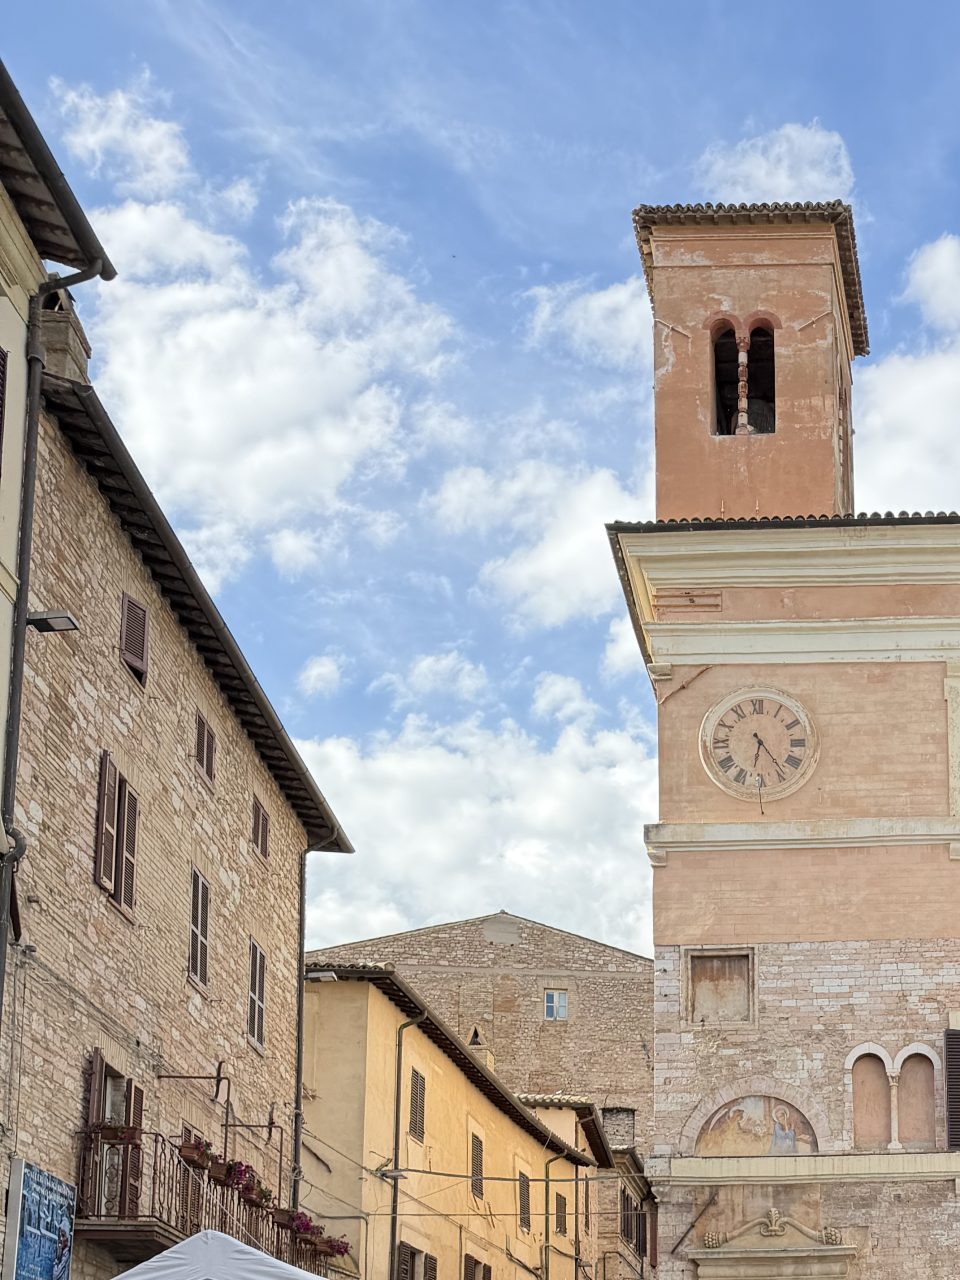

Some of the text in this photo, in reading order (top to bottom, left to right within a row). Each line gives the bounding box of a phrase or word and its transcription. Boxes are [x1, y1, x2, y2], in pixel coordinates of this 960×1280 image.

[731, 704, 746, 721] XI
[751, 699, 763, 714] XII
[718, 719, 734, 733] X
[785, 719, 800, 730] II
[713, 738, 729, 750] IX
[790, 739, 805, 748] III
